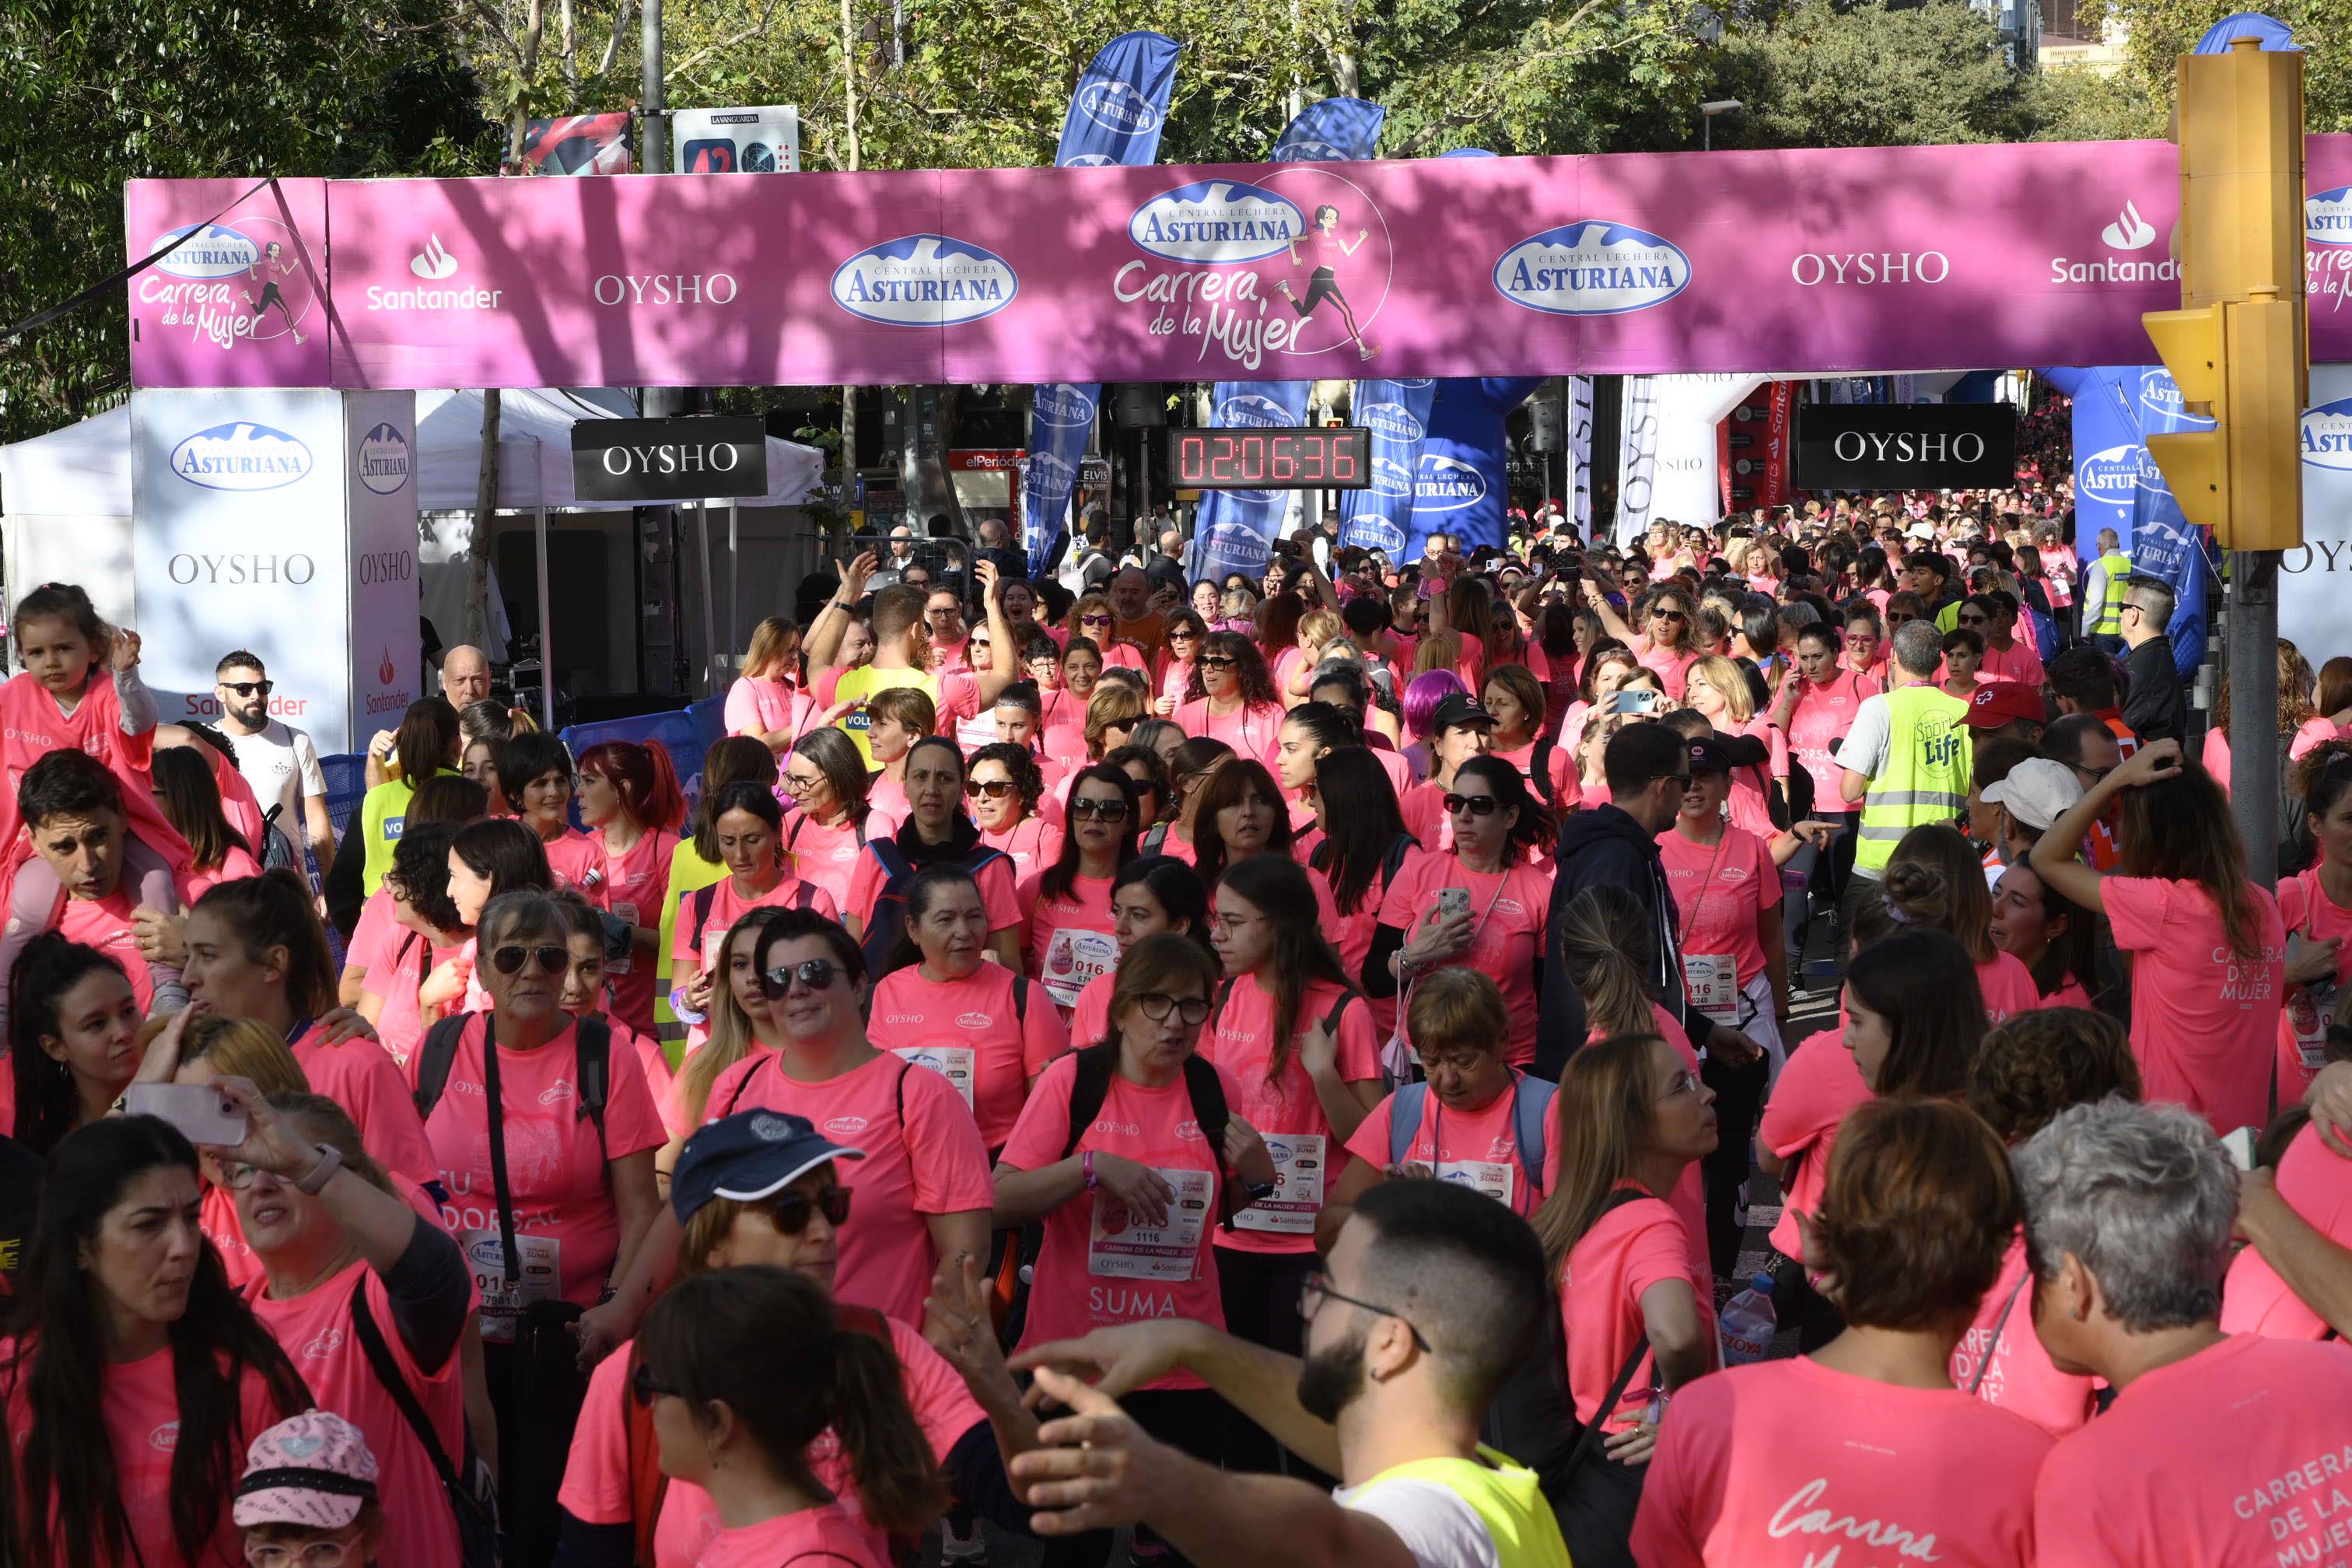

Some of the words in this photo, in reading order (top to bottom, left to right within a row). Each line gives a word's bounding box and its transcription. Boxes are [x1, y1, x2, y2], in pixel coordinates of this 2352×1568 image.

[1168, 207, 1224, 219] CENTRAL
[1229, 206, 1287, 218] LECHERA
[1141, 212, 1291, 244] ASTURIANA
[873, 265, 933, 275] CENTRAL
[938, 264, 997, 275] LECHERA
[1538, 251, 1599, 265] CENTRAL
[1606, 250, 1669, 263] LECHERA
[1791, 250, 1949, 286] OYSHO
[2050, 256, 2183, 284] Santand
[846, 268, 1003, 303] ASTURIANA
[1113, 259, 1259, 303] Carrera
[1508, 256, 1675, 293] ASTURIANA
[2323, 271, 2338, 294] la
[139, 275, 229, 305] Carrera
[366, 285, 502, 311] Santander
[593, 273, 738, 306] OYSHO
[162, 306, 178, 325] de
[183, 306, 194, 325] la
[193, 301, 265, 349] Mujer
[1149, 306, 1175, 336] de
[1181, 306, 1202, 336] la
[1198, 296, 1313, 370] Mujer
[180, 447, 303, 474] ASTURIANA
[603, 442, 739, 477] OYSHO
[966, 453, 1024, 467] elPeriódi
[1182, 436, 1356, 480] 02:06:36
[1833, 431, 1985, 464] OYSHO
[362, 449, 407, 477] ASTURIANA
[1083, 470, 1108, 481] ELVIS
[1654, 457, 1703, 471] YSHO
[1416, 481, 1480, 497] URIANA
[2084, 467, 2137, 489] ASTUR
[168, 553, 315, 585] OYSHO
[359, 549, 411, 586] OYSHO
[366, 688, 409, 716] Santander
[5, 728, 53, 748] OYSHO
[1916, 714, 1955, 743] Sport
[1924, 733, 1960, 767] Life
[384, 822, 404, 835] VO
[1045, 901, 1080, 915] OYSHO
[1077, 941, 1110, 955] ASTURIANA
[1075, 960, 1104, 975] 016
[1047, 991, 1074, 1002] OYSHO
[2218, 982, 2272, 1000] MUJER
[886, 1013, 924, 1024] OYSHO
[1219, 1027, 1255, 1043] OYSHO
[1095, 1120, 1140, 1136] OYSHO
[1279, 1216, 1314, 1226] Santander
[1136, 1232, 1160, 1244] 1116
[1157, 1247, 1178, 1255] MUJER
[1101, 1258, 1135, 1269] OYSHO
[1089, 1286, 1177, 1318] SUMA
[1720, 1332, 1762, 1355] EZOYA
[2233, 1445, 2352, 1519] CARRERA
[1767, 1478, 1943, 1562] Carrera
[2270, 1507, 2309, 1542] DE
[2311, 1488, 2352, 1520] LA
